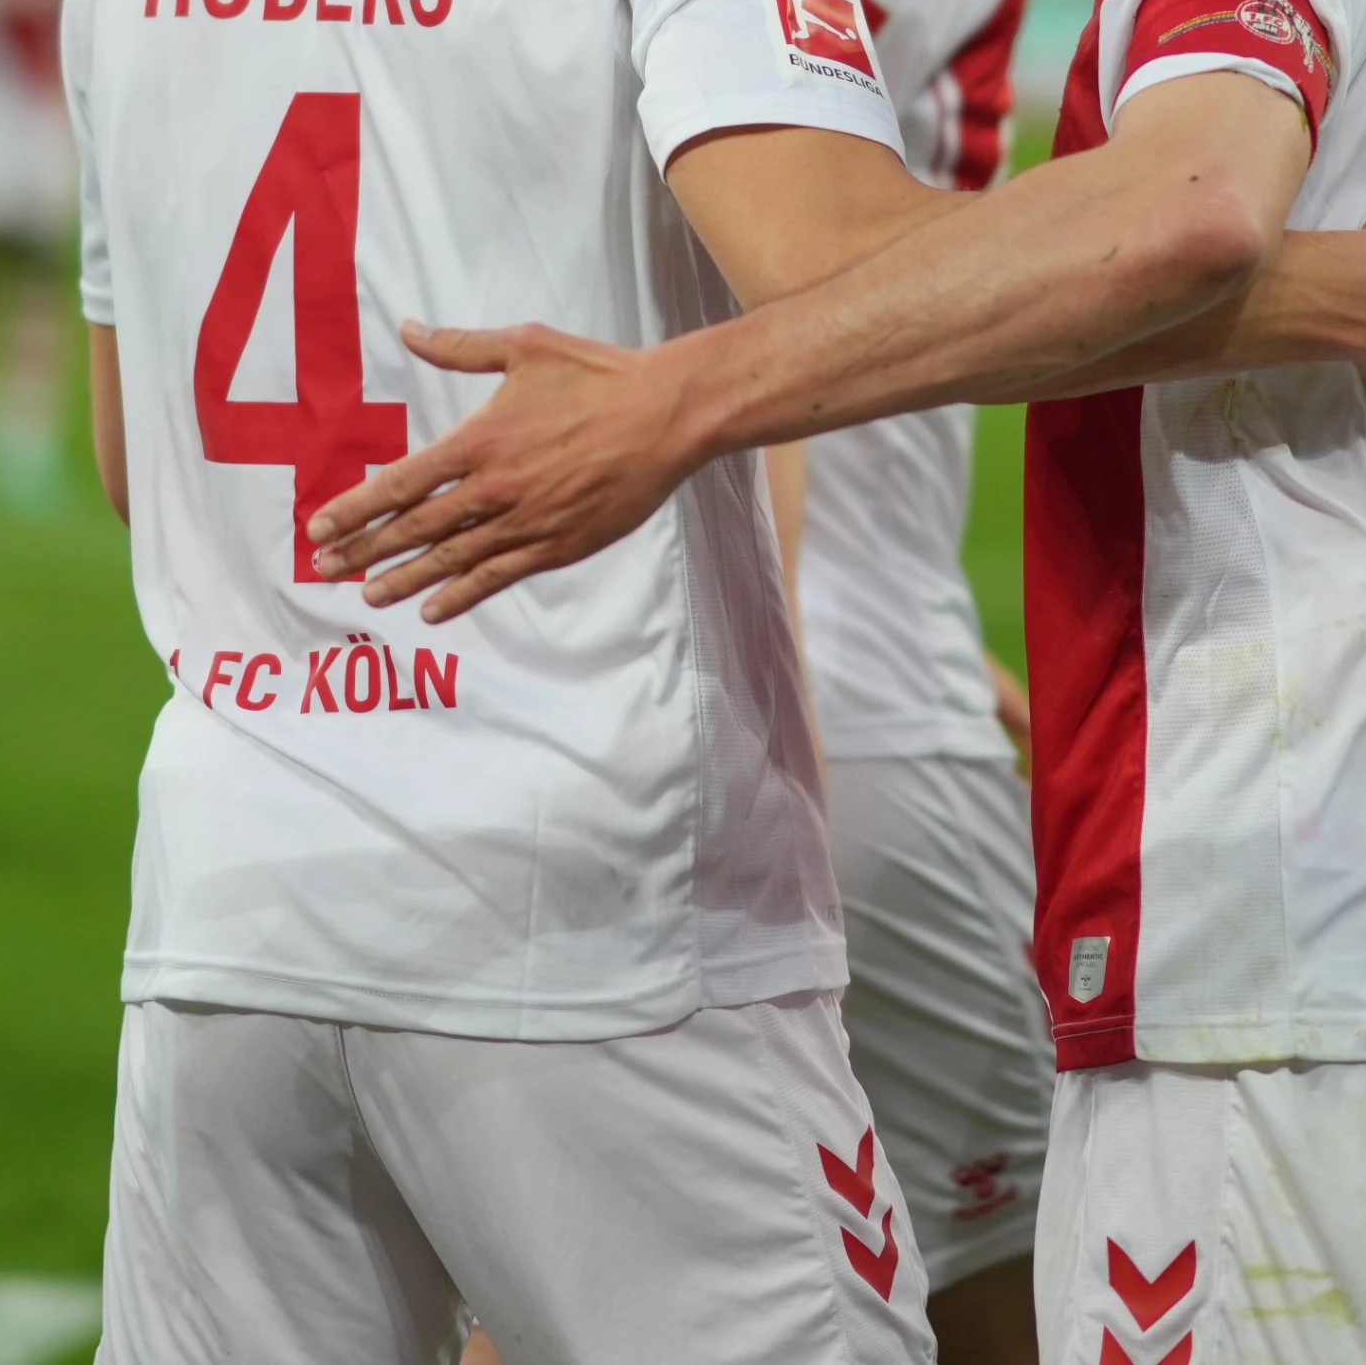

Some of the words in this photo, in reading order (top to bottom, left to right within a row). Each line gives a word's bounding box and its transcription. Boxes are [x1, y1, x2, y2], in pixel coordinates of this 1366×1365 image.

[788, 53, 885, 100] BUNDESLIGA
[192, 91, 409, 583] 4
[202, 650, 282, 712] FC
[299, 632, 460, 715] KÖLN
